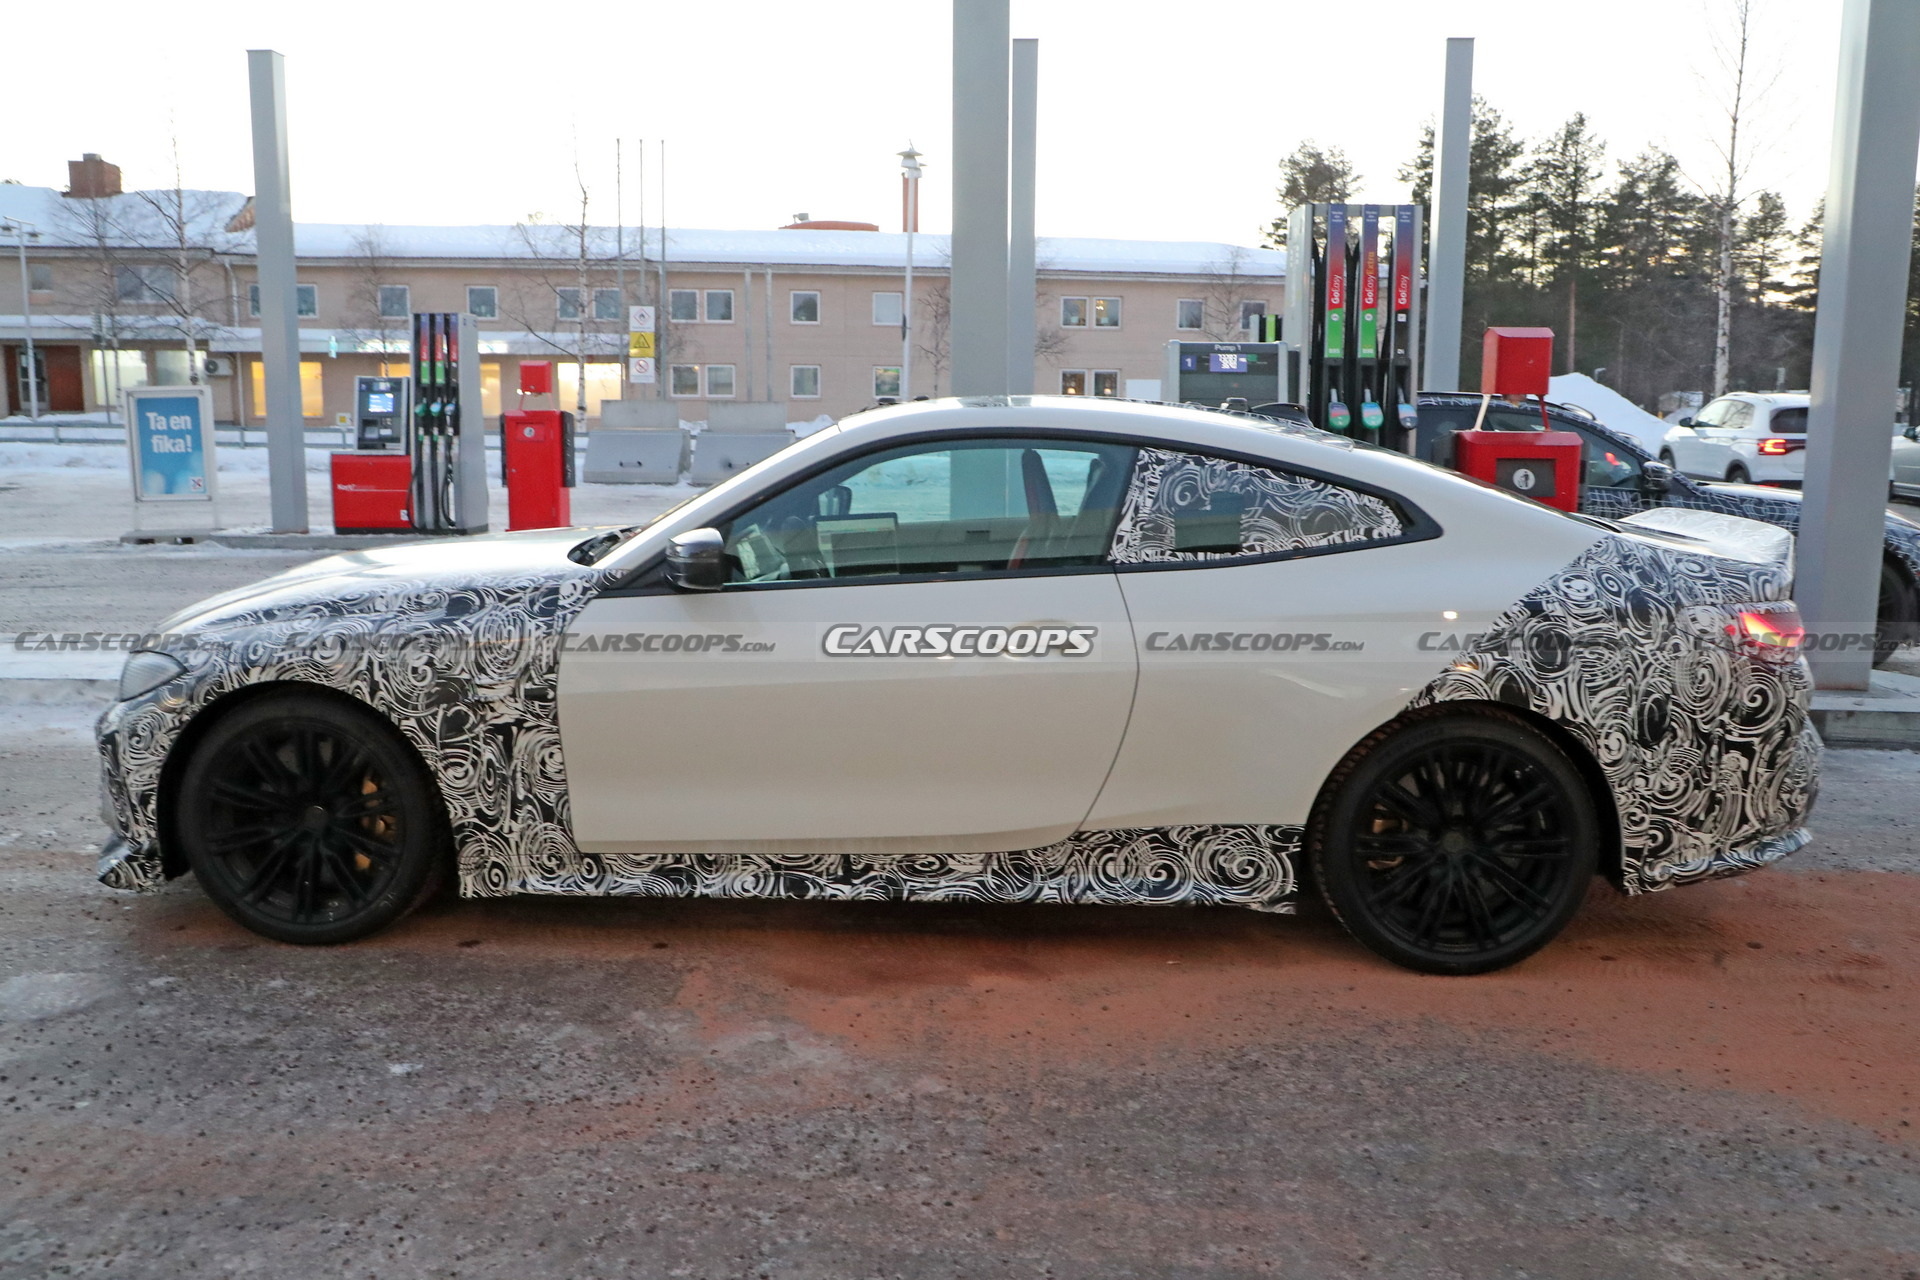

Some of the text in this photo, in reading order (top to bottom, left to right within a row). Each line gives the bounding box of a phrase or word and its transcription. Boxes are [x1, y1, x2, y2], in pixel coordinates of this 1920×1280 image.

[1185, 358, 1192, 367] 1
[145, 412, 192, 430] Ta en
[151, 434, 193, 453] fika!
